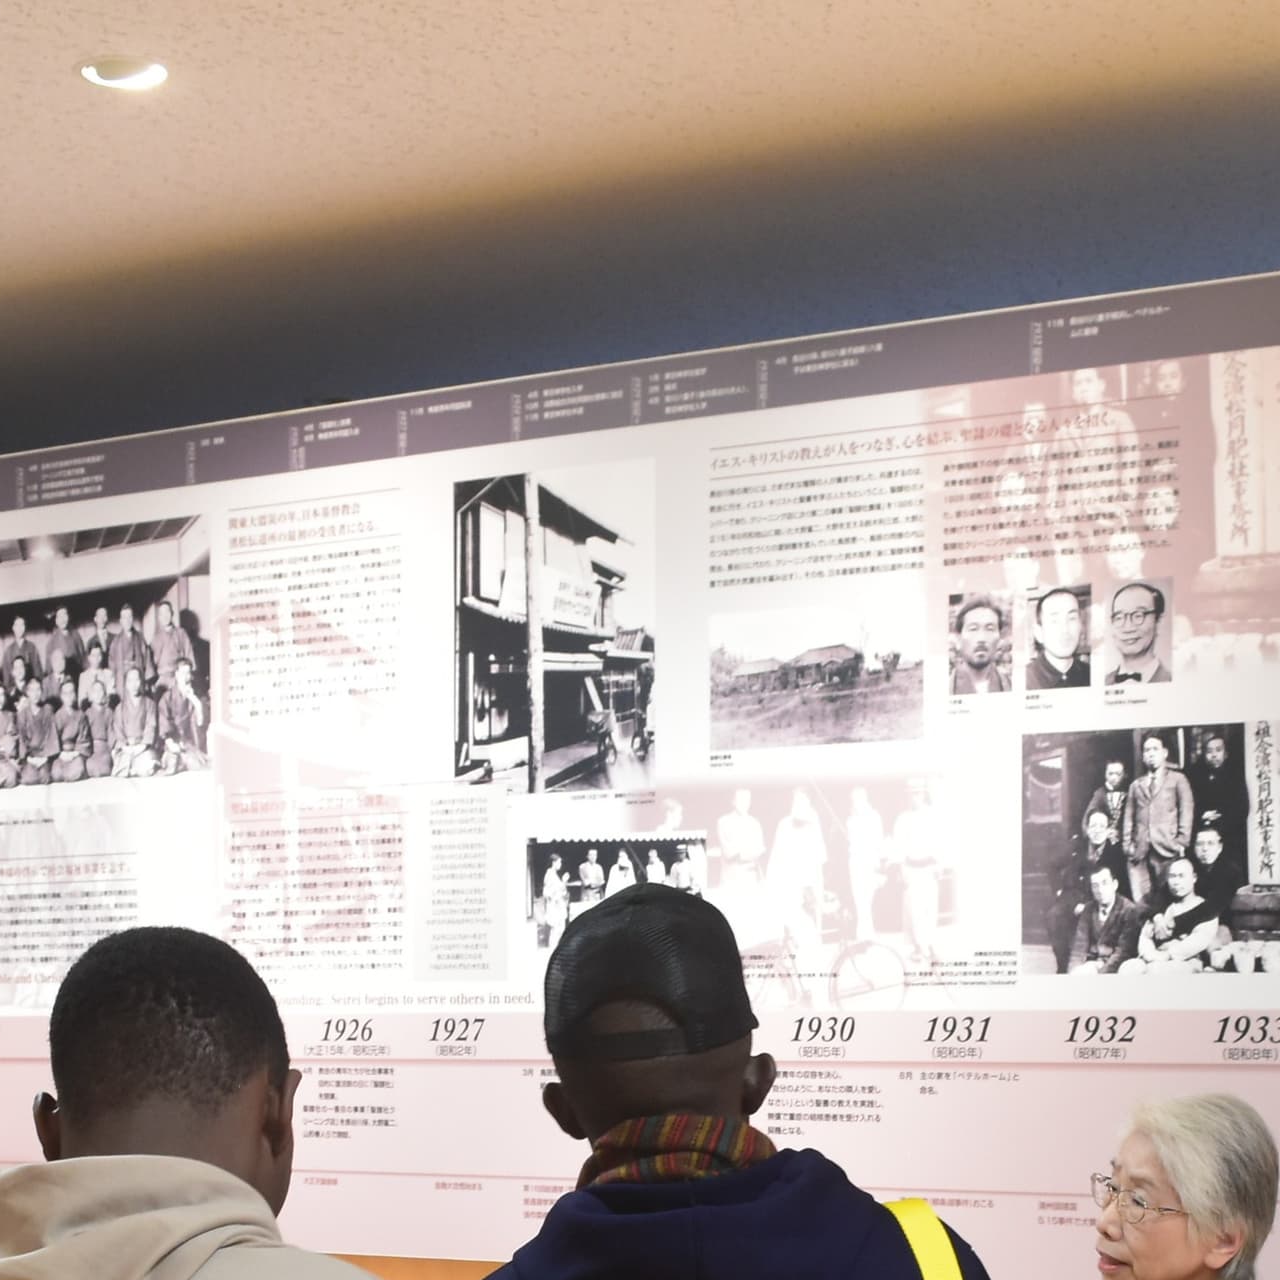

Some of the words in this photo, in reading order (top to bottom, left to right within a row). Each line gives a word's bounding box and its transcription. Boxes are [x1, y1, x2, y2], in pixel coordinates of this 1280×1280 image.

[449, 992, 485, 1005] others
[488, 992, 500, 1004] in
[504, 992, 535, 1005] need.
[320, 1018, 374, 1042] 1926
[428, 1018, 486, 1042] 1927
[790, 1016, 856, 1042] 1930
[923, 1016, 992, 1043] 1931
[1064, 1015, 1138, 1043] 1932
